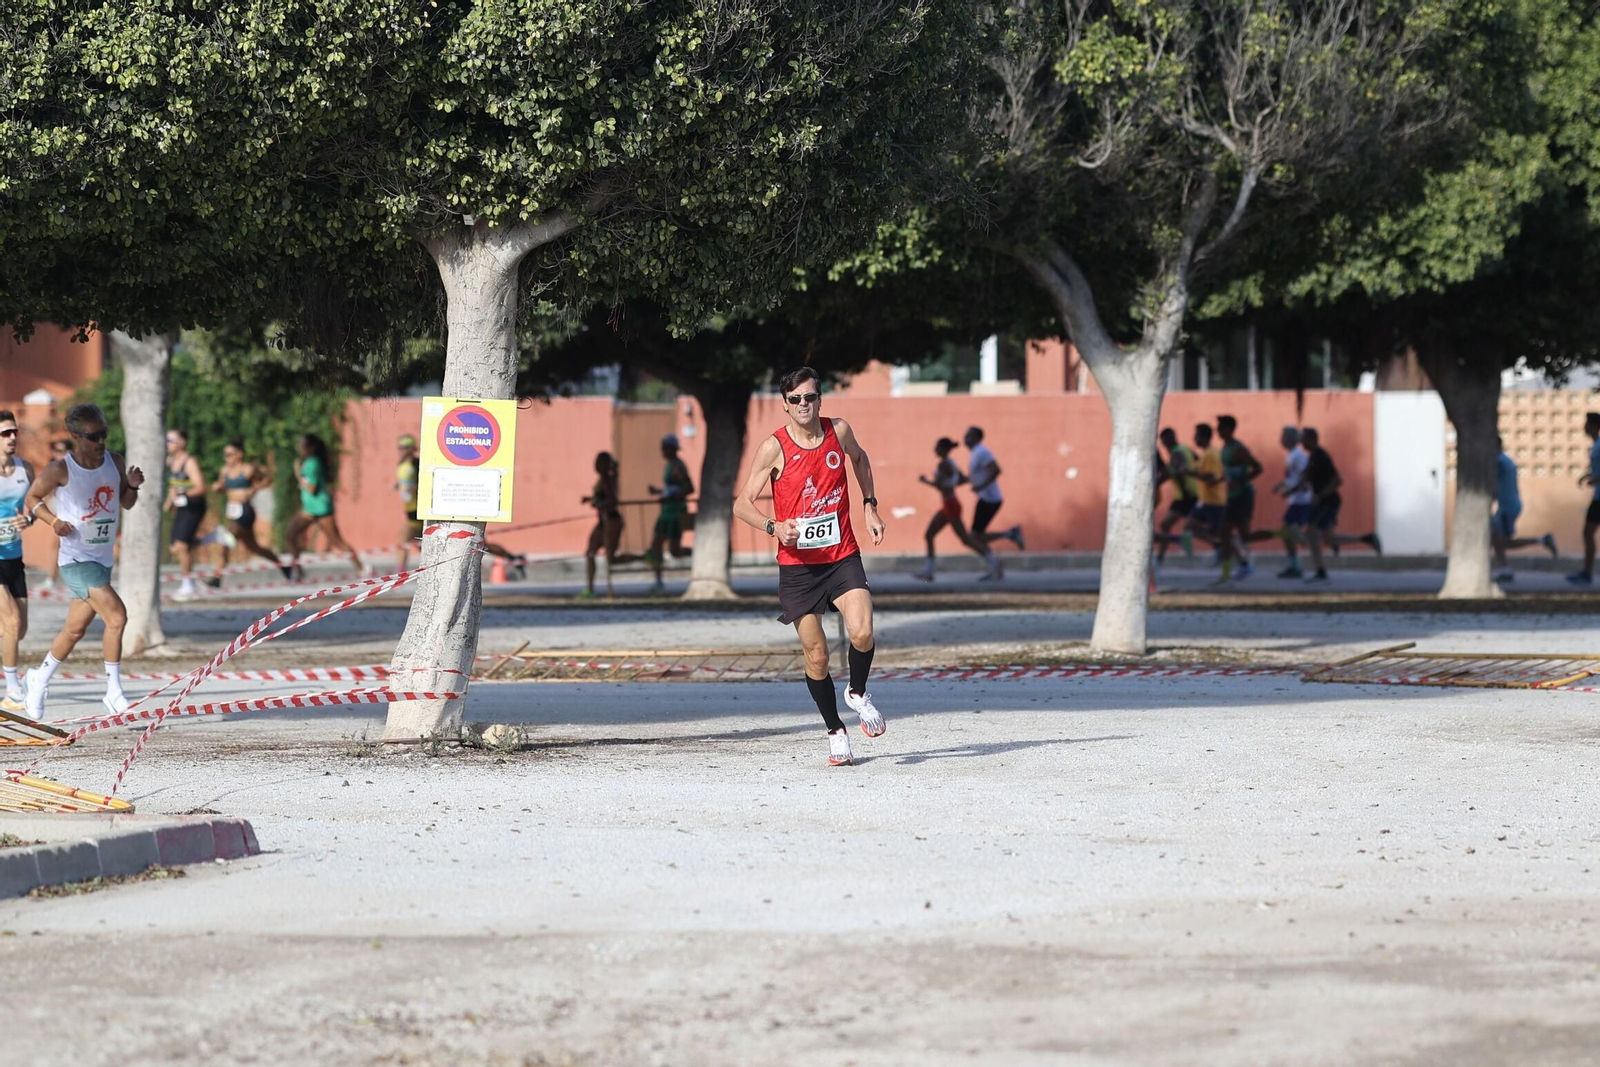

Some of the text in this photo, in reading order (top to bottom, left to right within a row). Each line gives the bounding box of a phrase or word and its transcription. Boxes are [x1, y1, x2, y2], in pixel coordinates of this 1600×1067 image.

[449, 426, 490, 435] PROHIBIDO
[446, 437, 492, 446] ESTACIONAR
[97, 525, 109, 537] 14
[804, 522, 833, 540] 661
